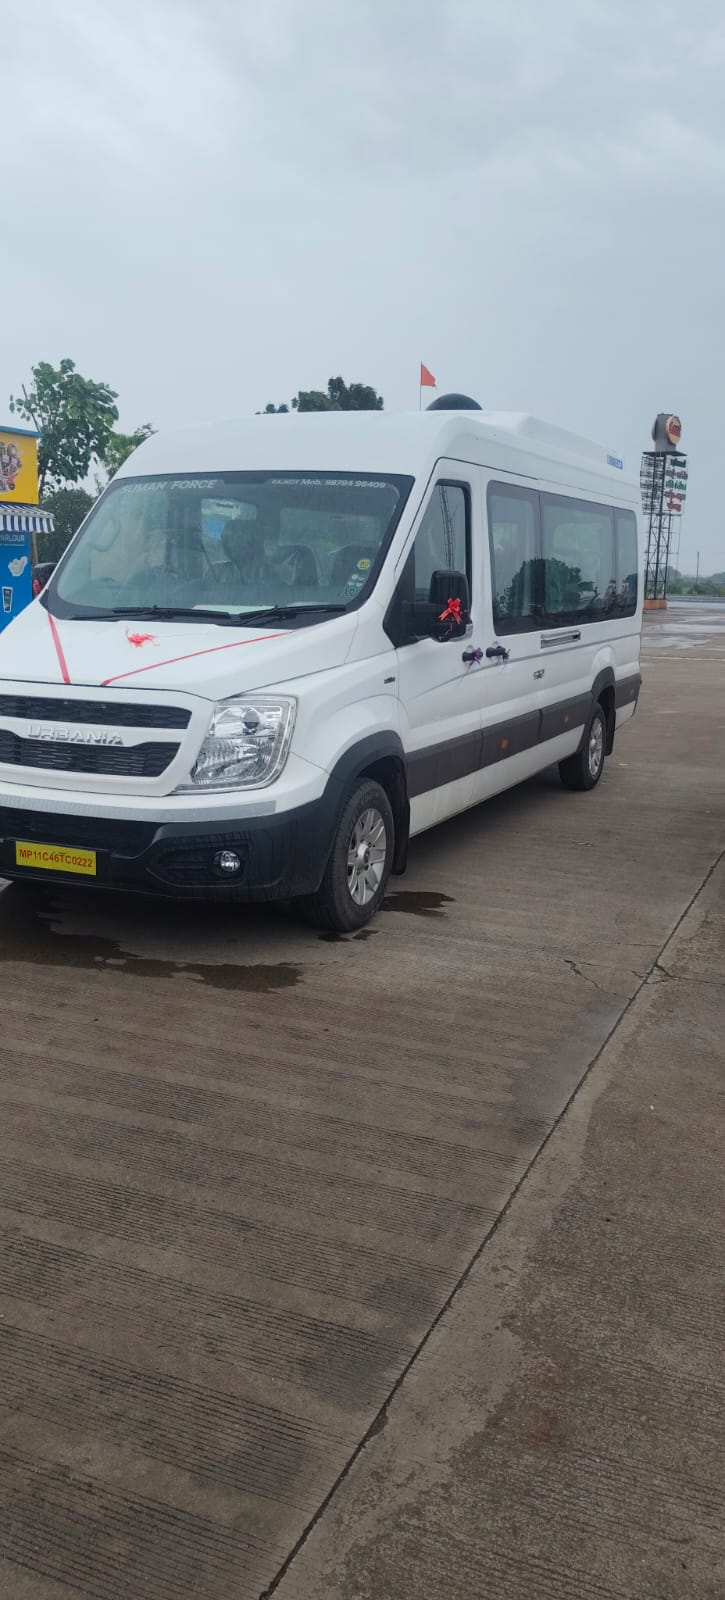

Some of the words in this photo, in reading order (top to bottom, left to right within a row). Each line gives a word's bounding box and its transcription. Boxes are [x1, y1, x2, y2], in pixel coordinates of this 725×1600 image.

[120, 481, 168, 494] SUMAN
[170, 480, 217, 490] FORCE
[27, 724, 124, 745] URBANIA
